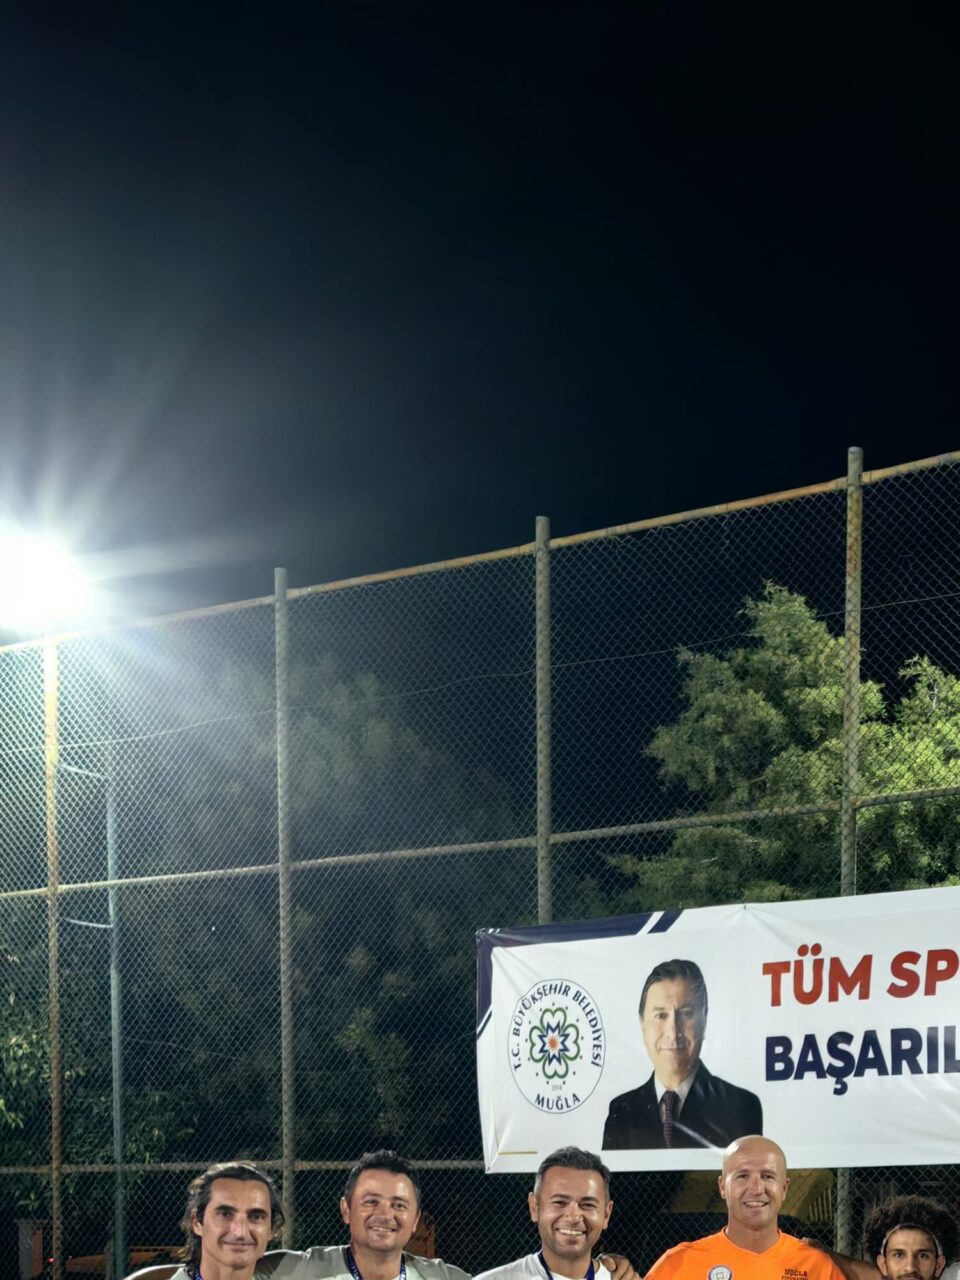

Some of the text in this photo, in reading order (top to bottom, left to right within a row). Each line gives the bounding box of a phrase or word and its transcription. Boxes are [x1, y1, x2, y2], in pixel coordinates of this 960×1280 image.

[762, 943, 873, 1007] TÜM
[512, 981, 571, 1037] BÜYÜKŞEHİR
[572, 990, 603, 1068] BELEDİYESİ
[535, 1093, 581, 1111] MUĞLA
